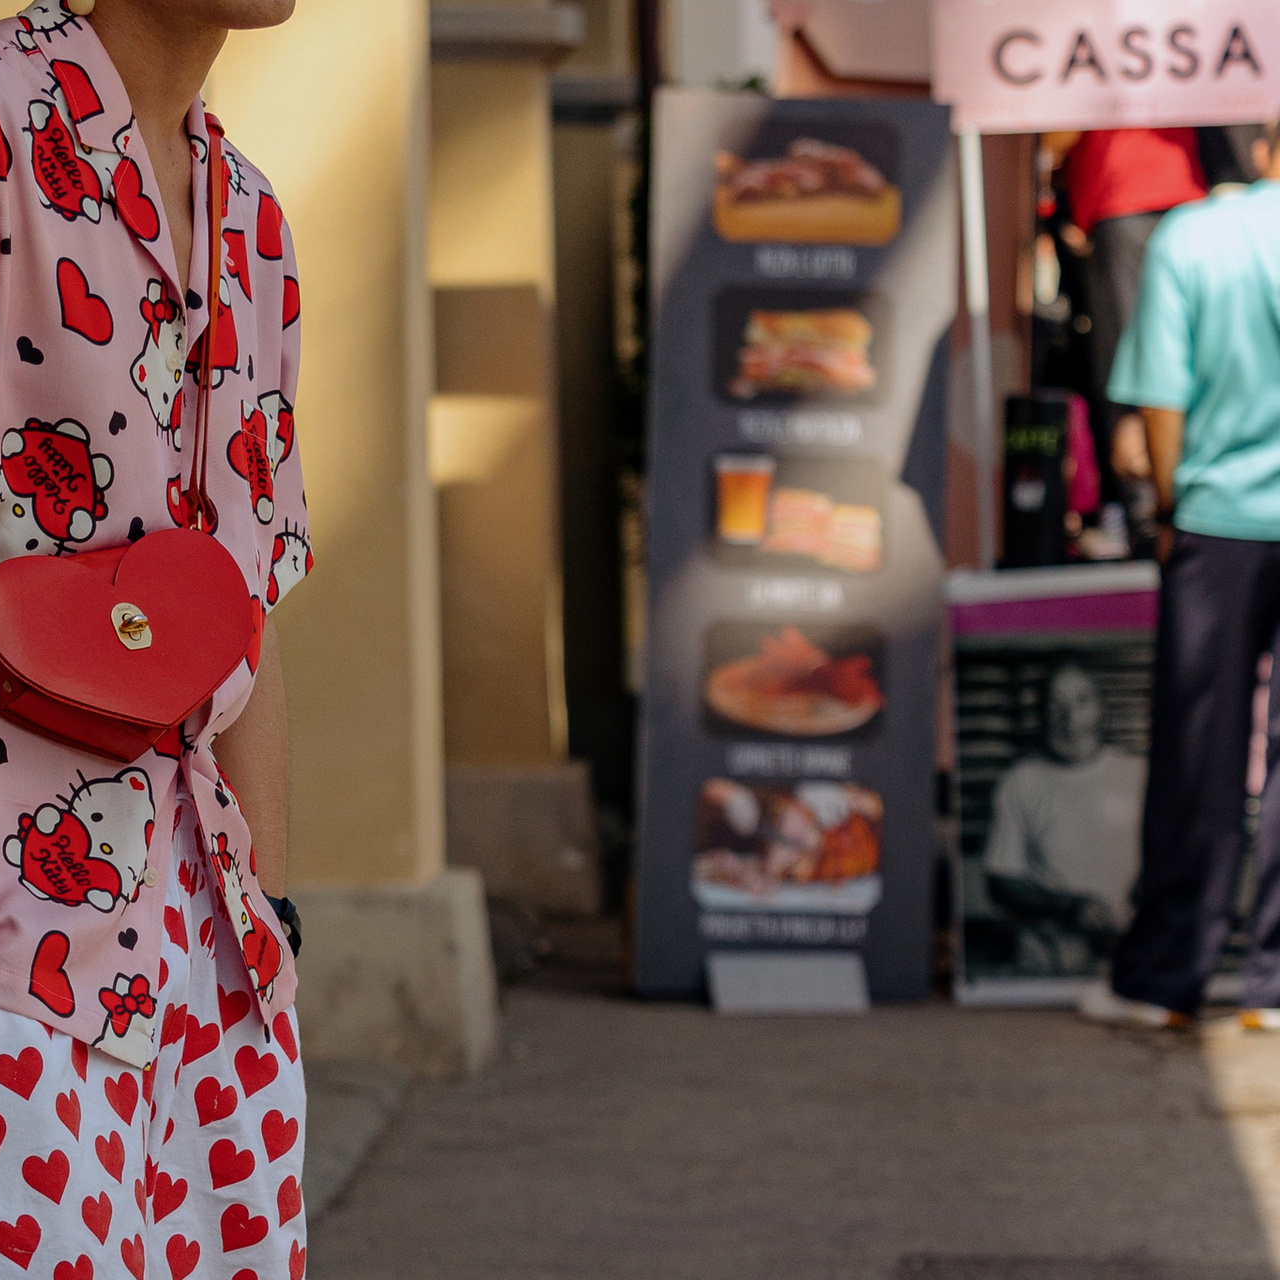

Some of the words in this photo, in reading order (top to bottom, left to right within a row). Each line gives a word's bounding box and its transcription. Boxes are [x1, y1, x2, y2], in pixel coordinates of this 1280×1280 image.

[991, 23, 1262, 85] CASSA
[43, 128, 84, 191] Hello
[23, 455, 71, 515] Hello
[38, 437, 87, 492] Kitty
[30, 848, 72, 894] Kitty
[50, 834, 91, 886] Hello
